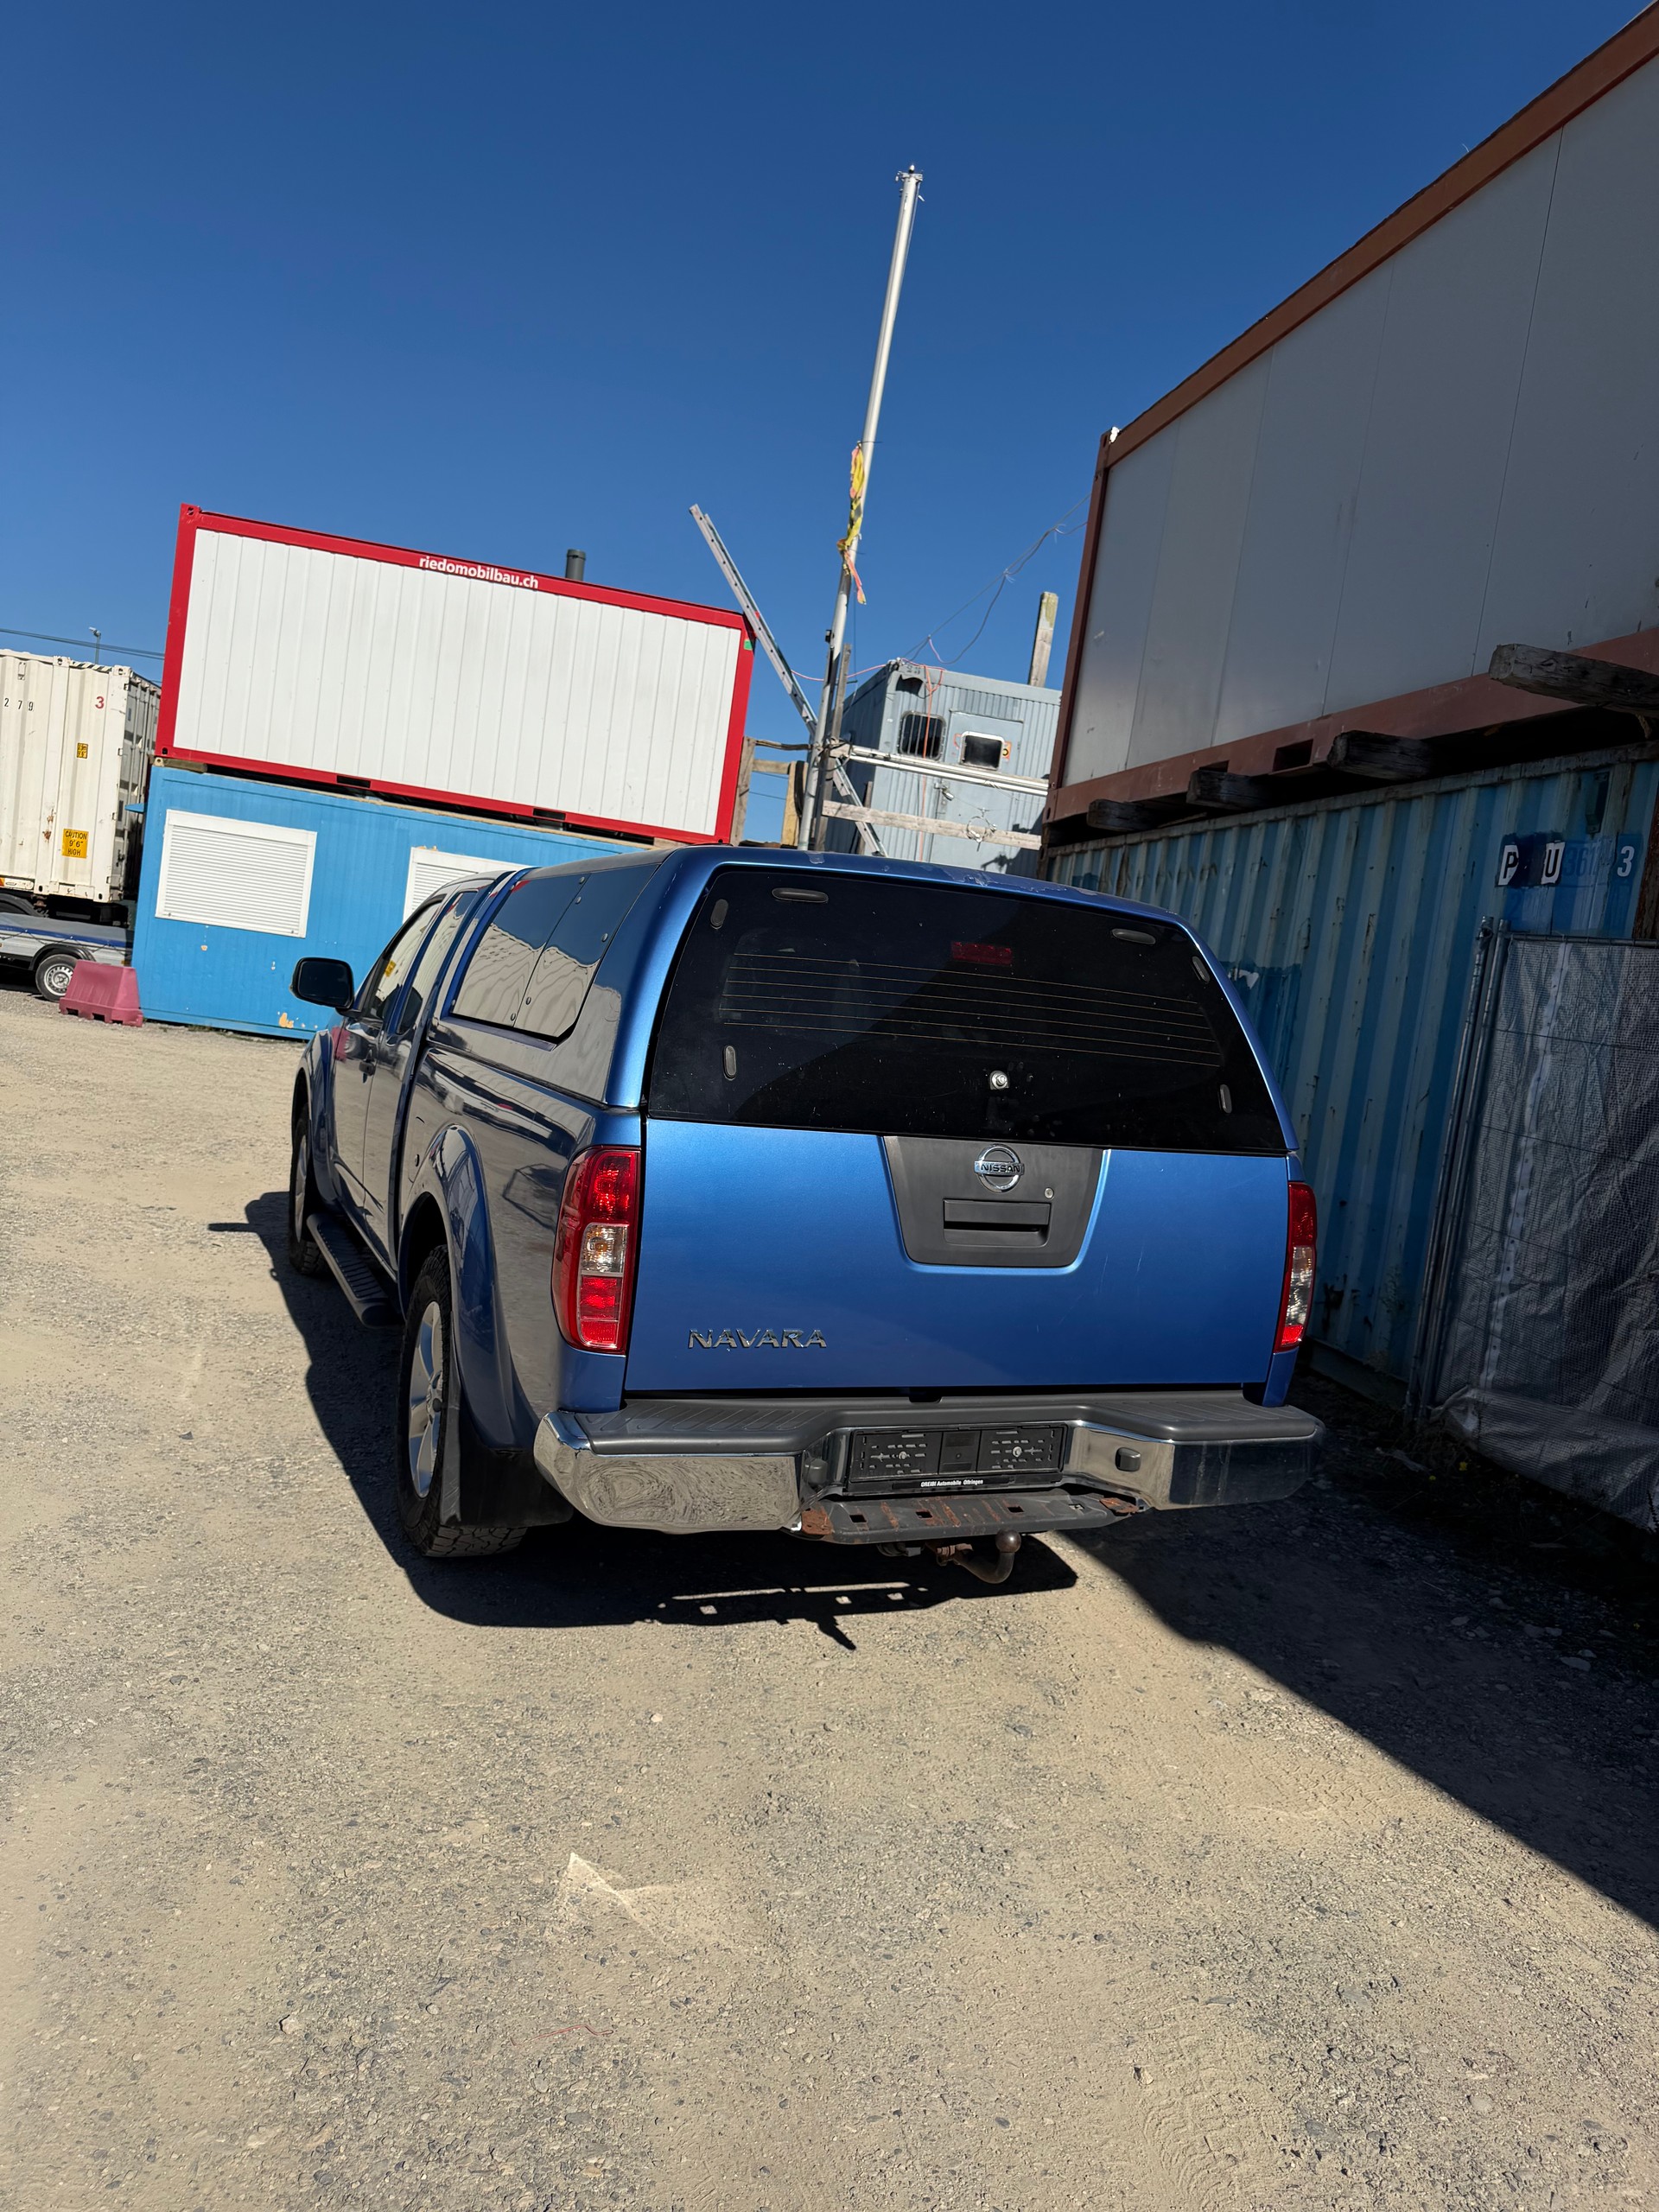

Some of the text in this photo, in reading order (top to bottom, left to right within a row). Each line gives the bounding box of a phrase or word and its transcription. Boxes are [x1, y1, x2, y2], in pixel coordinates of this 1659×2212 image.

[419, 556, 539, 589] riedomobilbau.ch
[95, 696, 105, 709] 3
[65, 830, 87, 840] CAUTION
[67, 848, 81, 856] HIGH
[1617, 845, 1636, 877] 3
[981, 1164, 1020, 1173] NISSAN
[688, 1329, 827, 1349] NAVARA
